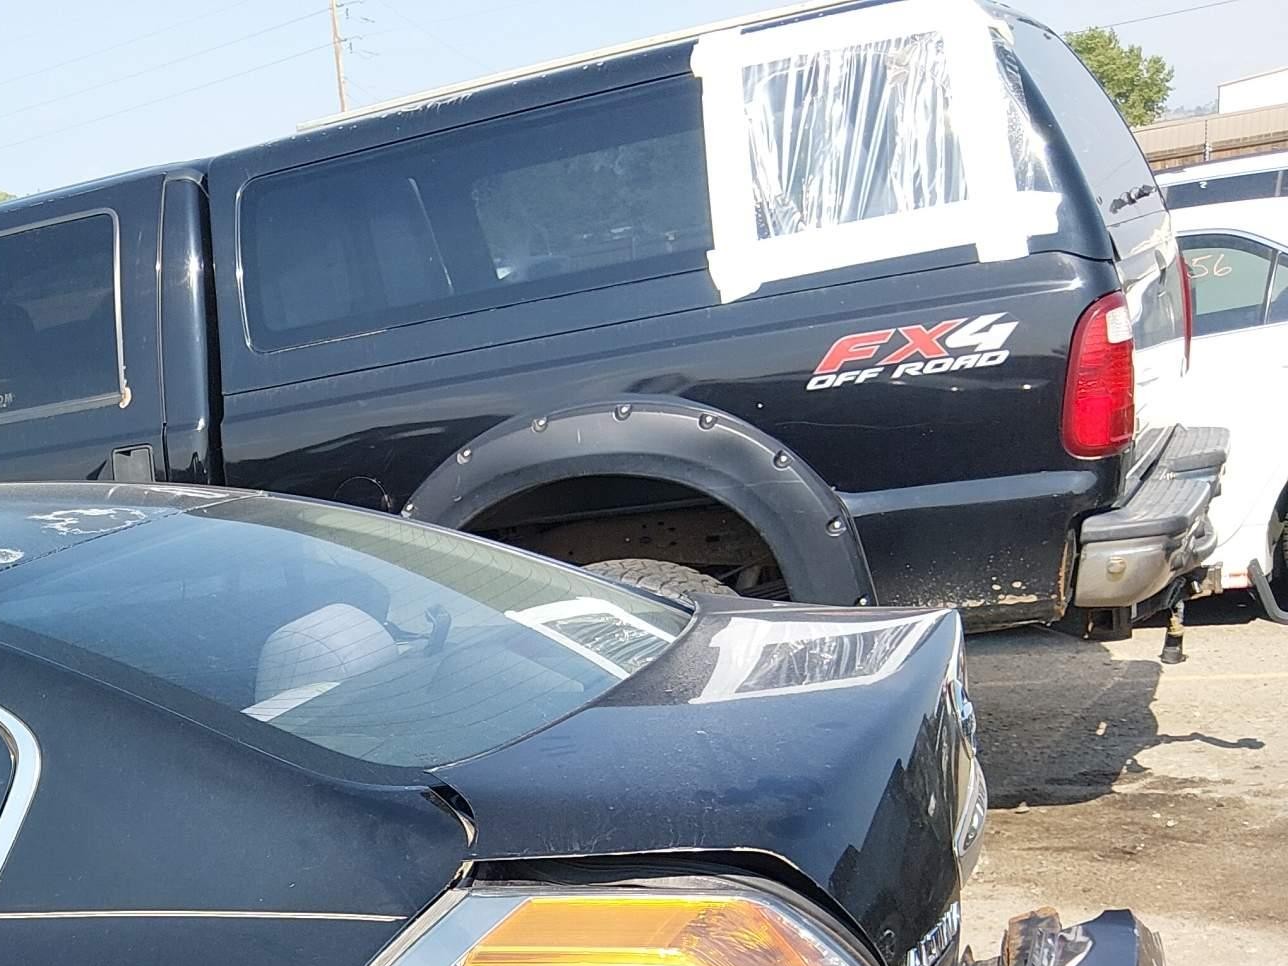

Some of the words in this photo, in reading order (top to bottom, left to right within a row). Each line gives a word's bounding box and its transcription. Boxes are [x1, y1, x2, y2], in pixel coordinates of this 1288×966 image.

[813, 312, 1019, 375] FX4
[806, 367, 885, 391] OFF
[890, 349, 1011, 379] ROAD
